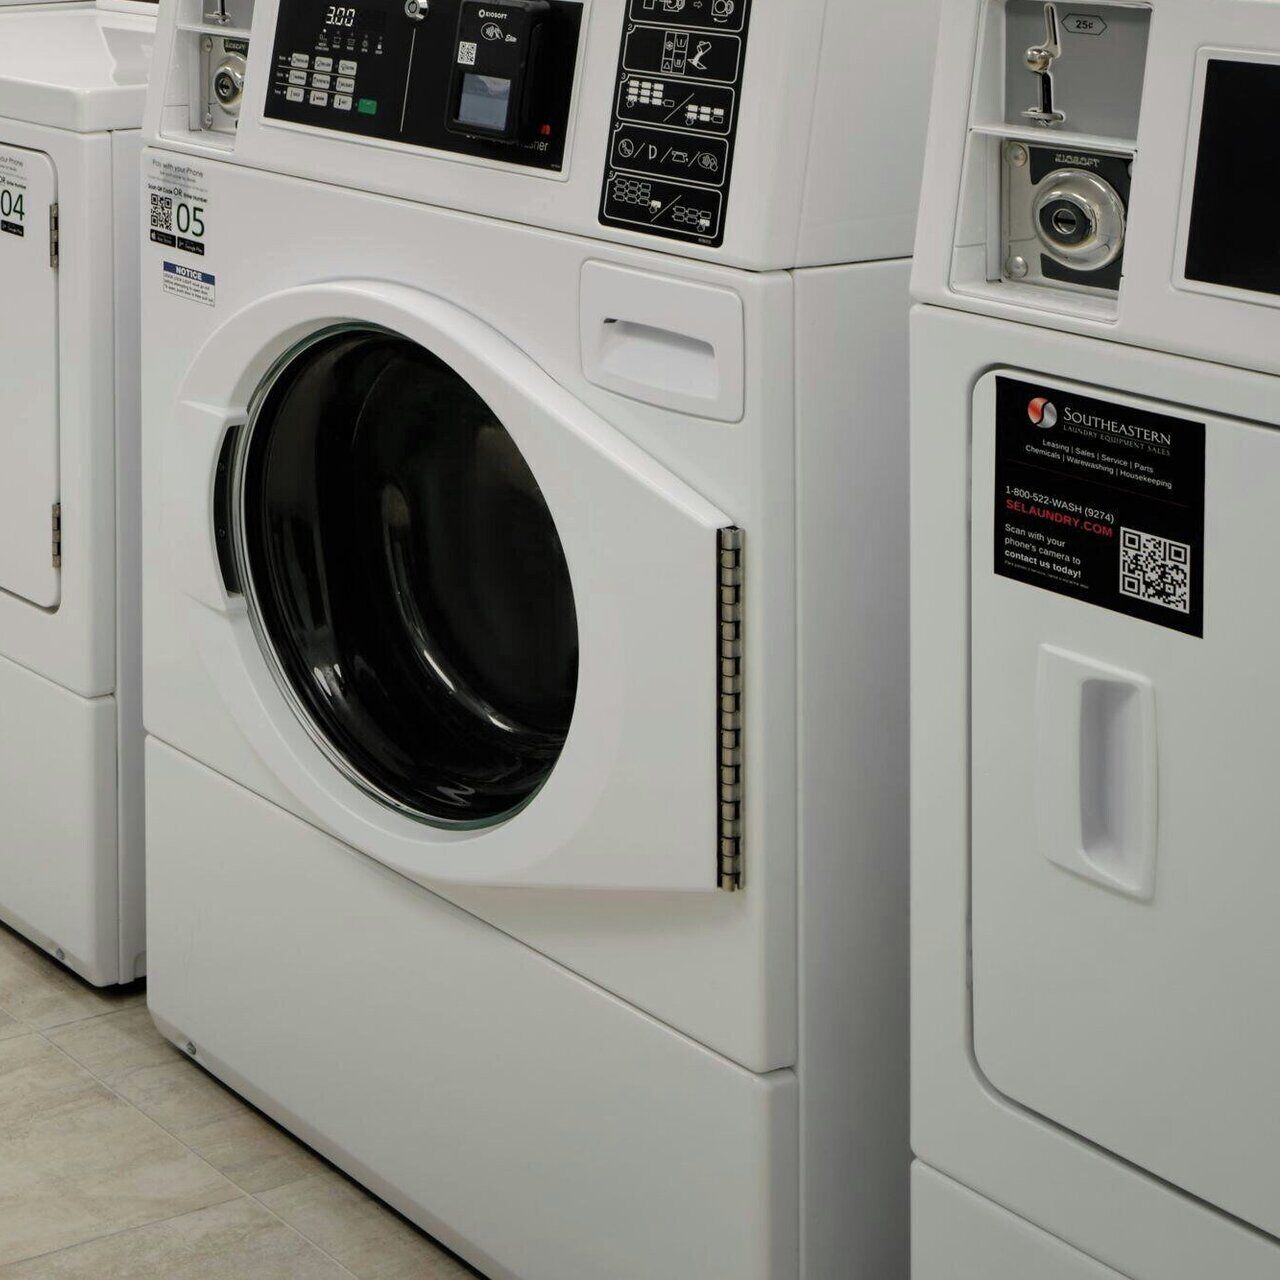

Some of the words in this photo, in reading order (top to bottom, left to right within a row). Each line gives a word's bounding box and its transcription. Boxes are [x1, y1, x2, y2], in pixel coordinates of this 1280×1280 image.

[326, 6, 355, 27] 3.00
[1, 189, 25, 221] 04
[177, 203, 205, 237] 05
[175, 266, 202, 280] NOTICE
[1063, 406, 1171, 446] SOUTHEASTERN
[1063, 424, 1098, 439] LAUNDRY
[1100, 433, 1144, 450] EQUIPMENT
[1147, 445, 1171, 457] SALES
[1025, 444, 1061, 460] Chemicals
[1066, 455, 1114, 475] Warewashing
[1120, 470, 1172, 490] Housekeeping
[1042, 438, 1070, 453] Leasing
[1075, 448, 1095, 459] Sales
[1101, 453, 1128, 467] Service
[1134, 462, 1154, 473] Parts
[1005, 485, 1082, 514] 1-800-522-WASH
[1085, 507, 1114, 524] (9274)
[1006, 499, 1113, 537] SELAUNDRY.COM
[1004, 537, 1037, 552] phone's
[1038, 547, 1071, 562] camera
[1072, 556, 1081, 565] to
[1005, 523, 1026, 535] Scan
[1027, 530, 1045, 542] with
[1046, 536, 1065, 548] your
[1004, 549, 1038, 565] contact
[1039, 560, 1051, 569] us
[1053, 563, 1082, 579] today!
